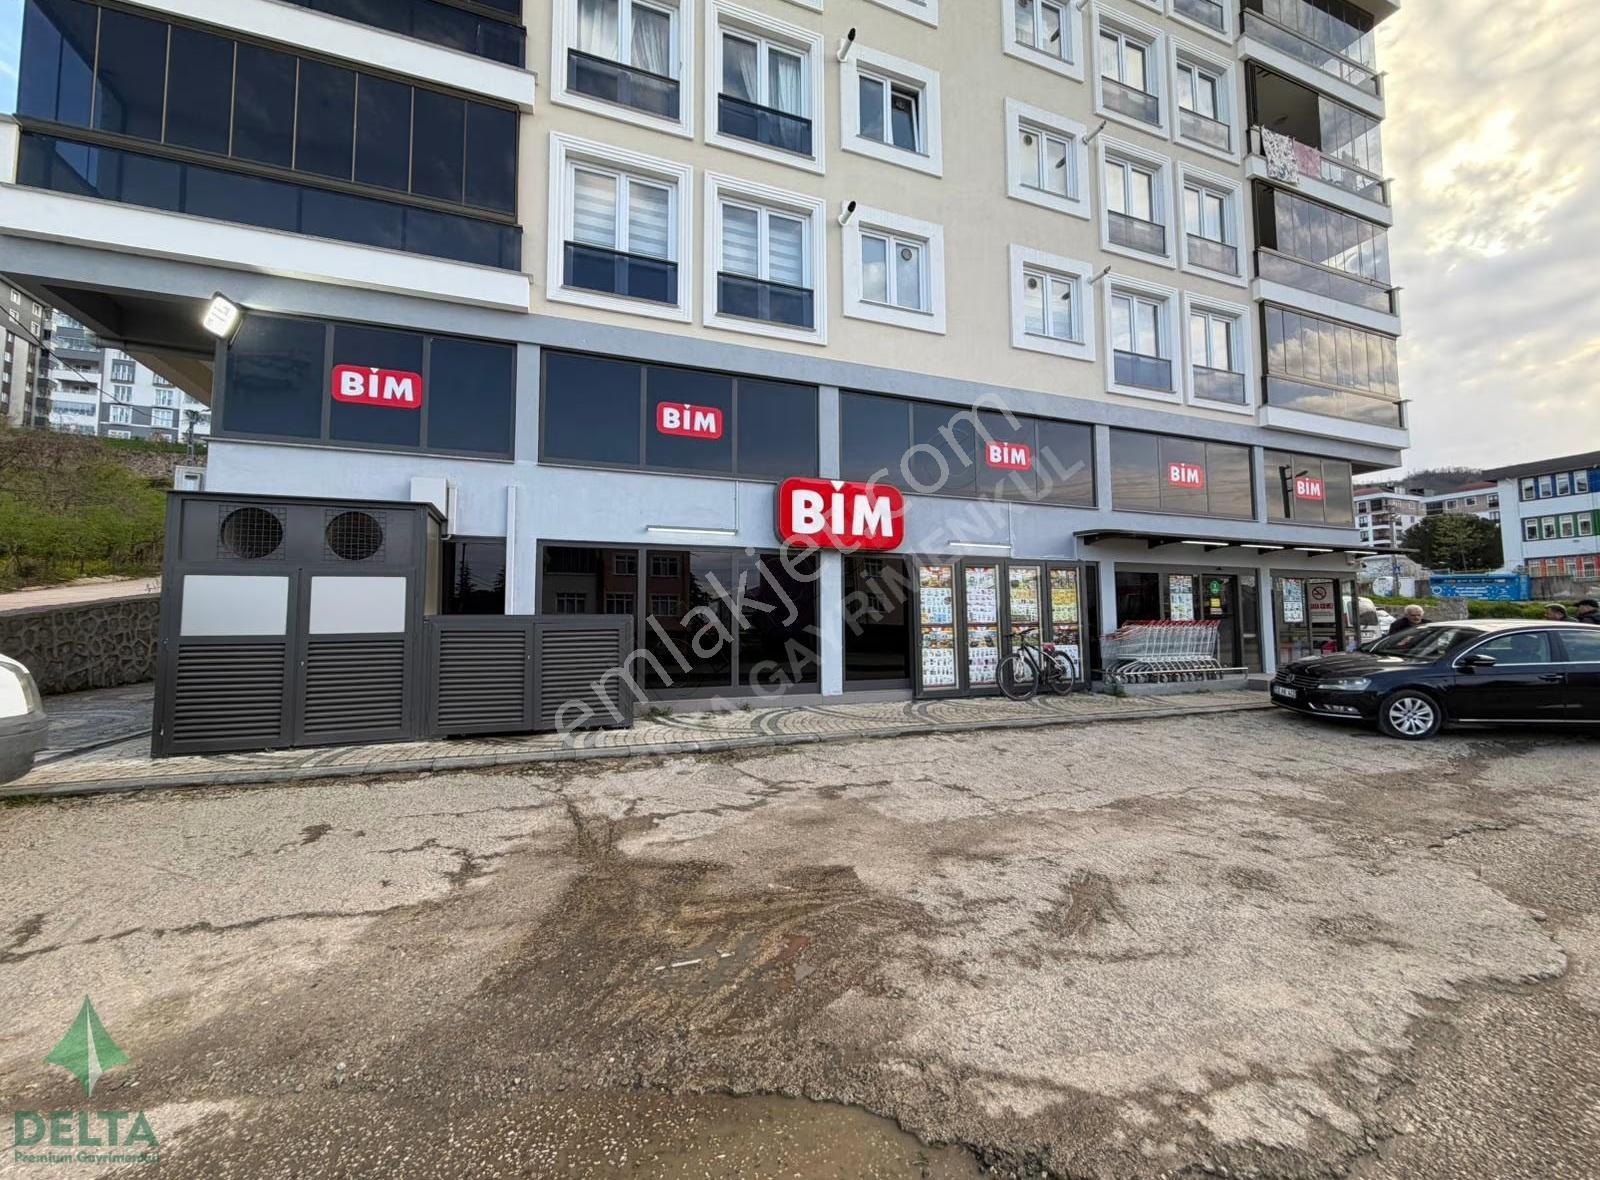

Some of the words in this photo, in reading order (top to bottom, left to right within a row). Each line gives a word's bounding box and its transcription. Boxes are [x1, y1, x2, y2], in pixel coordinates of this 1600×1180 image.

[340, 366, 414, 402] BİM
[663, 403, 717, 434] BİM
[988, 442, 1026, 466] BİM
[1169, 463, 1200, 485] BİM
[1296, 477, 1322, 499] BİM
[791, 479, 894, 539] BİM
